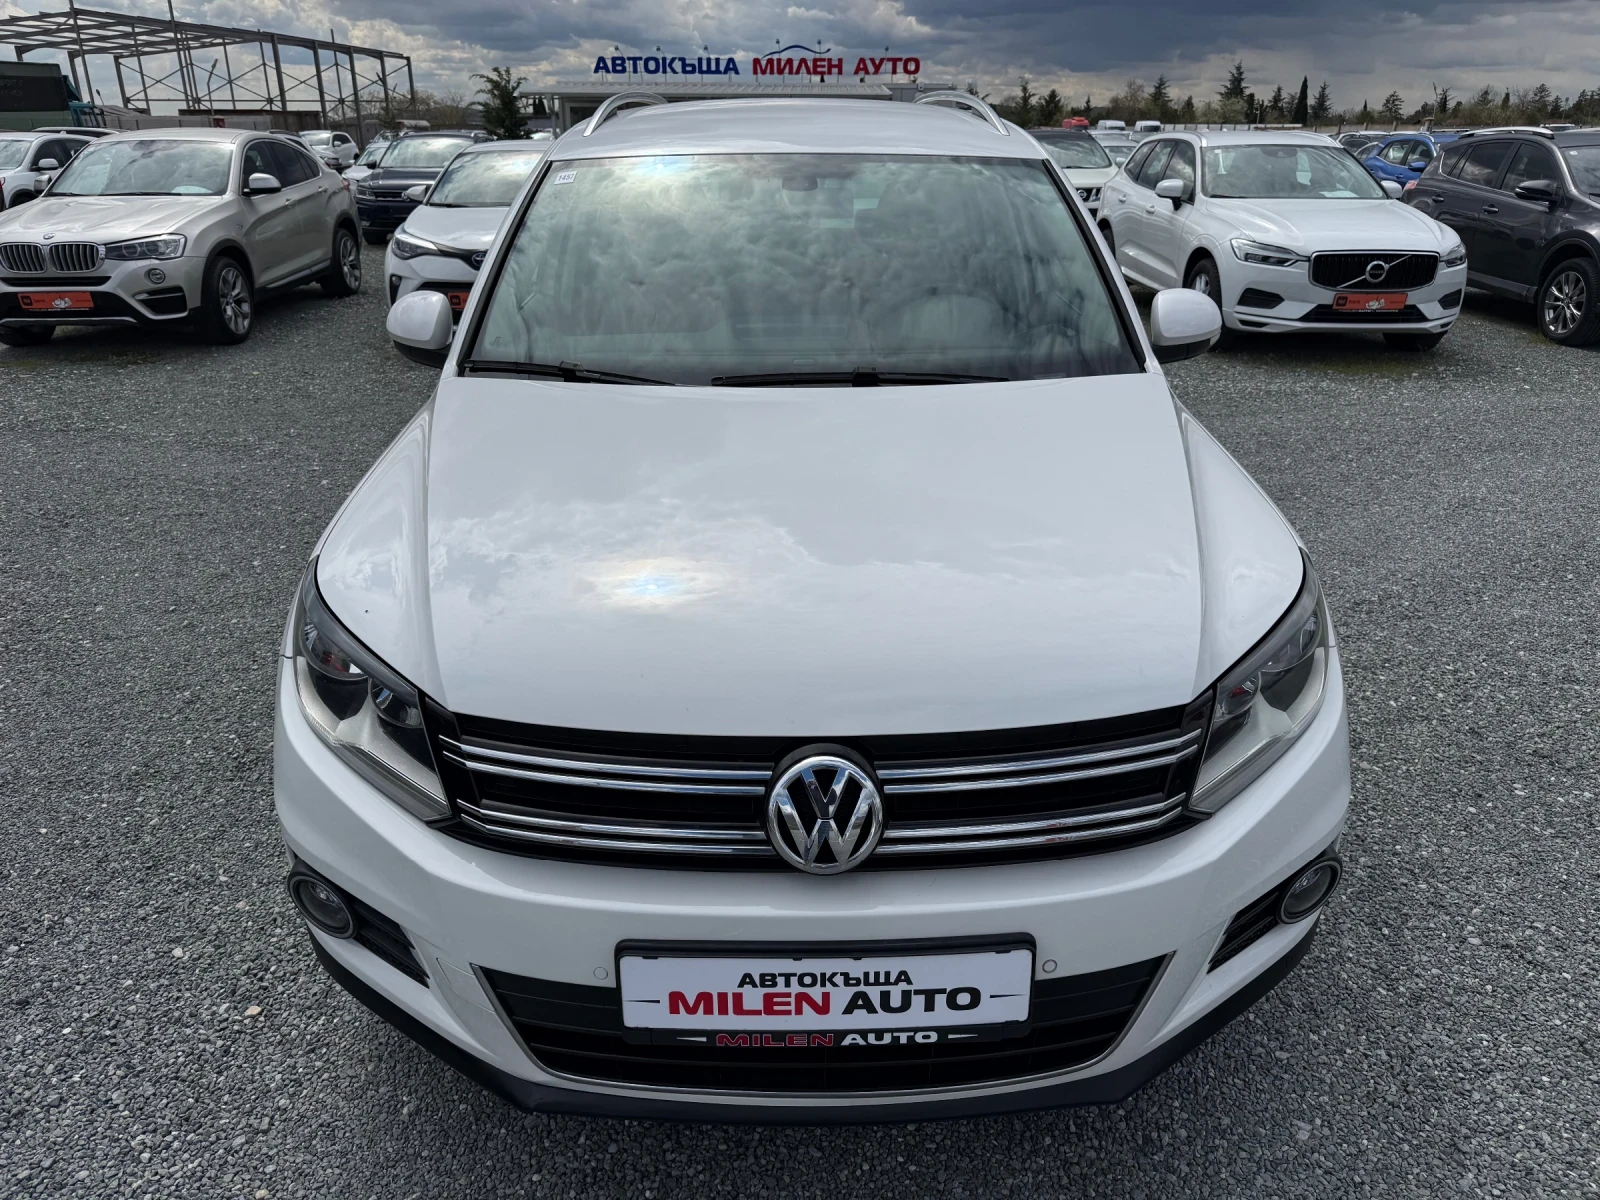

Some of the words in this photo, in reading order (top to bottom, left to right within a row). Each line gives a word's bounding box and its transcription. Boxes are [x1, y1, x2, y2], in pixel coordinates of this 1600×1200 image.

[752, 57, 843, 75] МИЛЕН
[853, 57, 920, 75] АУТО
[668, 991, 830, 1016] MILEN
[841, 986, 982, 1015] AUTO
[715, 1033, 834, 1047] MILEN
[840, 1031, 938, 1046] AUTO
